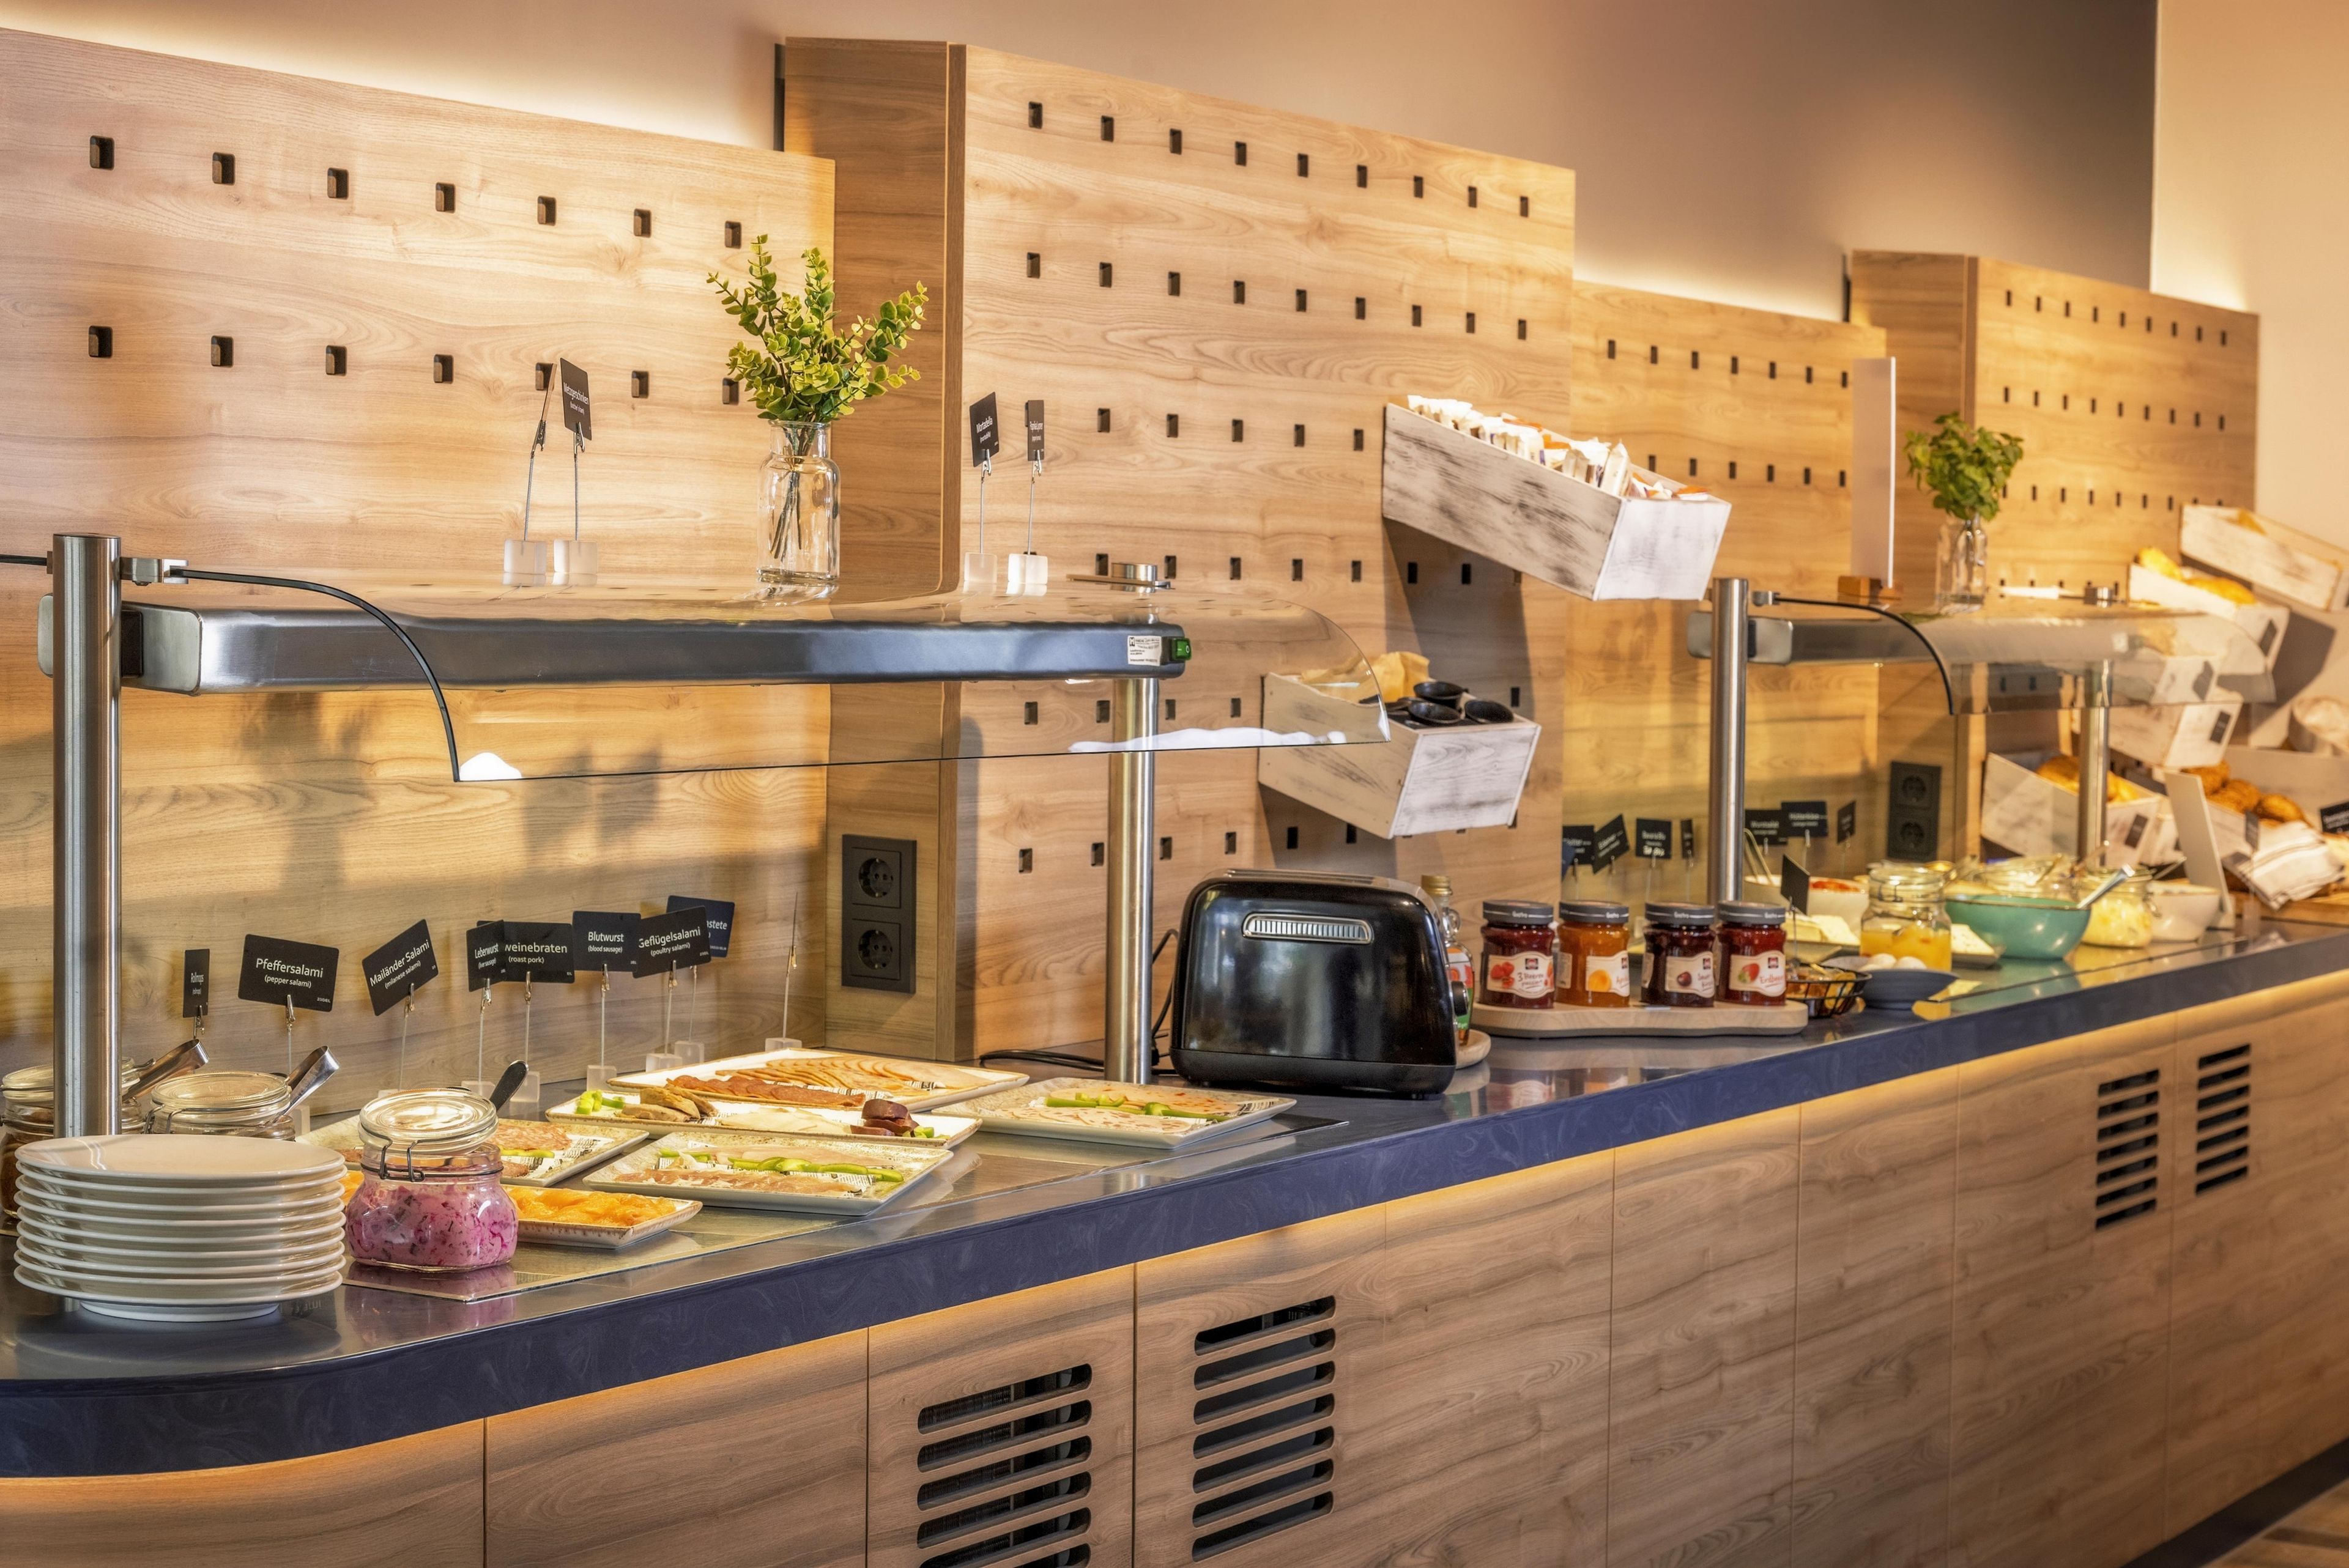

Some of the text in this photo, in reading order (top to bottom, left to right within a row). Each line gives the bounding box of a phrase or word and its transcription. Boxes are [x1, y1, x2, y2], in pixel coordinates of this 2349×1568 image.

[588, 931, 624, 942] Blutwurst
[475, 942, 499, 958] Leberwurst
[650, 942, 691, 956] (poultry salami)
[369, 939, 429, 986] Mailänder Salami
[527, 956, 544, 964] pork)
[256, 958, 324, 978] Pfeffersalami
[385, 960, 421, 989] (milanese salami)
[264, 974, 311, 988] (pepper salami)
[1518, 972, 1523, 982] 3
